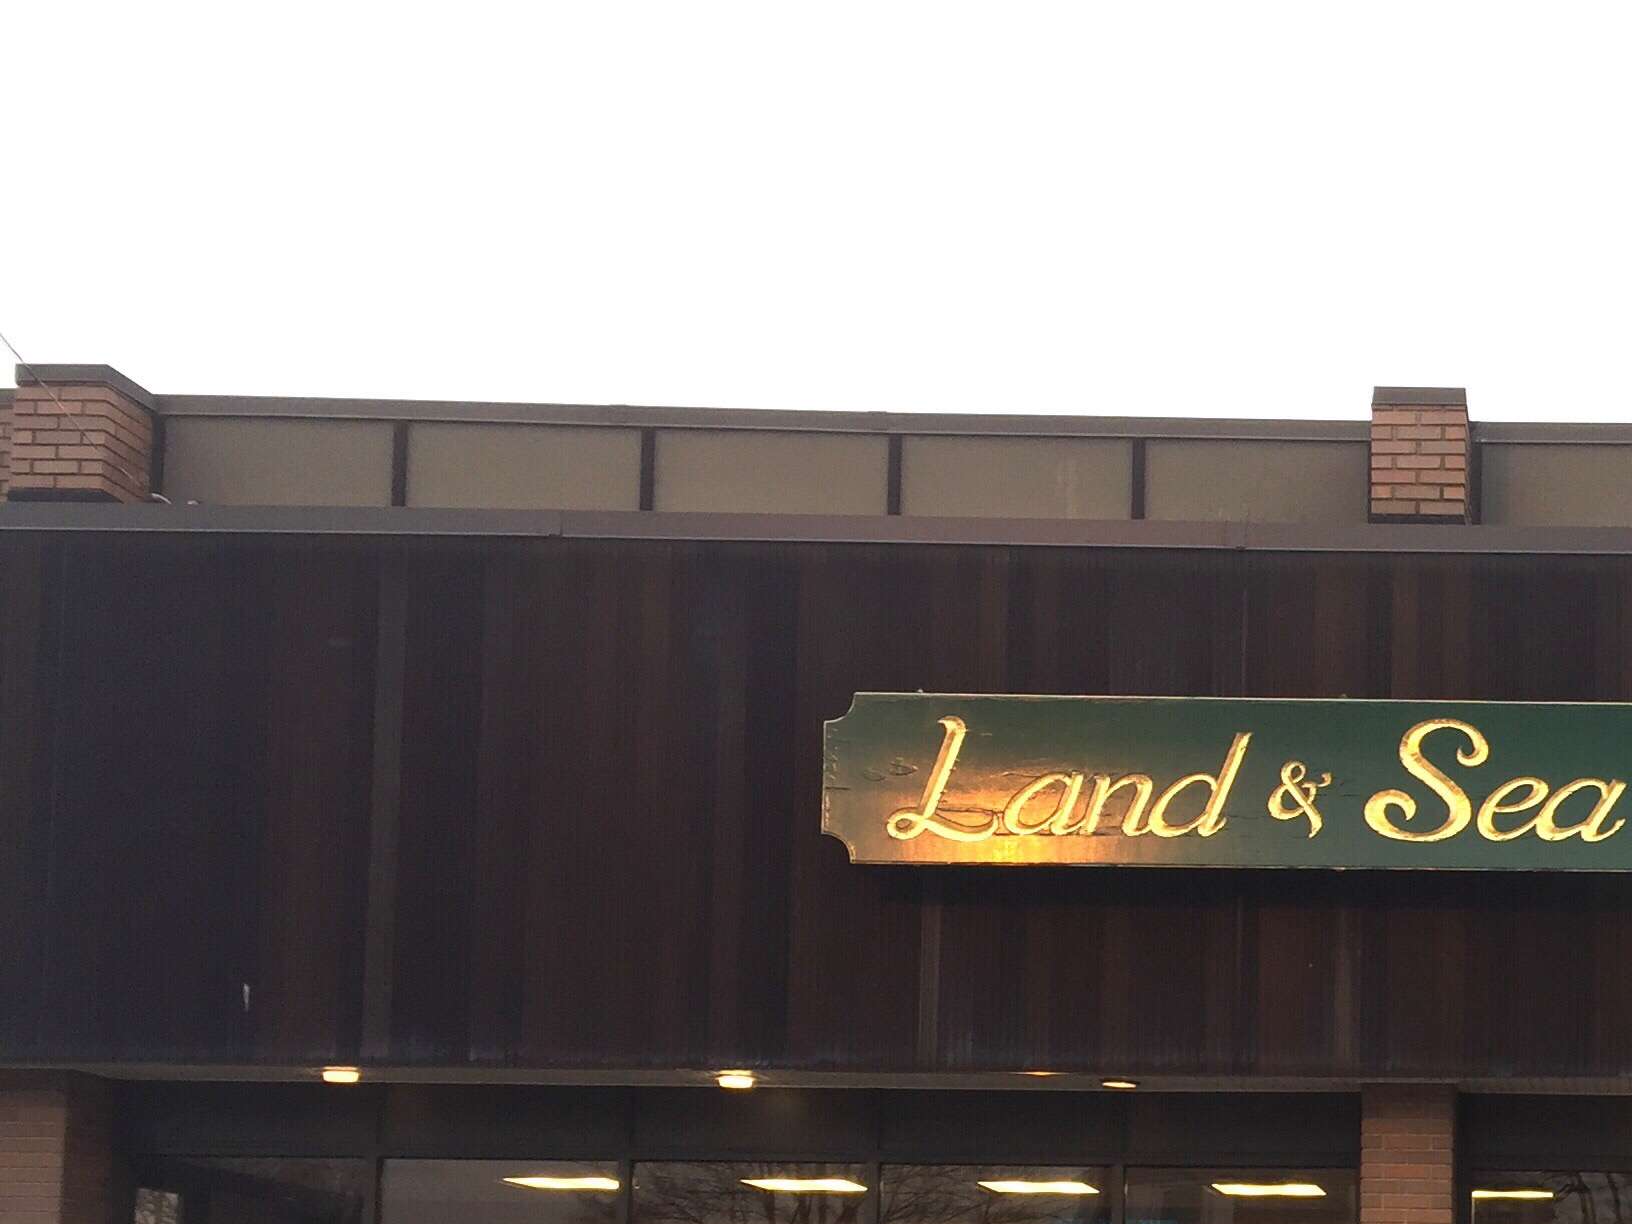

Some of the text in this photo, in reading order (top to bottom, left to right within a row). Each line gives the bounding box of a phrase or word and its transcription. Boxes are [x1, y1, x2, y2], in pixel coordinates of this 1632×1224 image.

[887, 715, 1253, 842] Land
[1267, 760, 1332, 839] &
[1364, 717, 1627, 844] Sea
